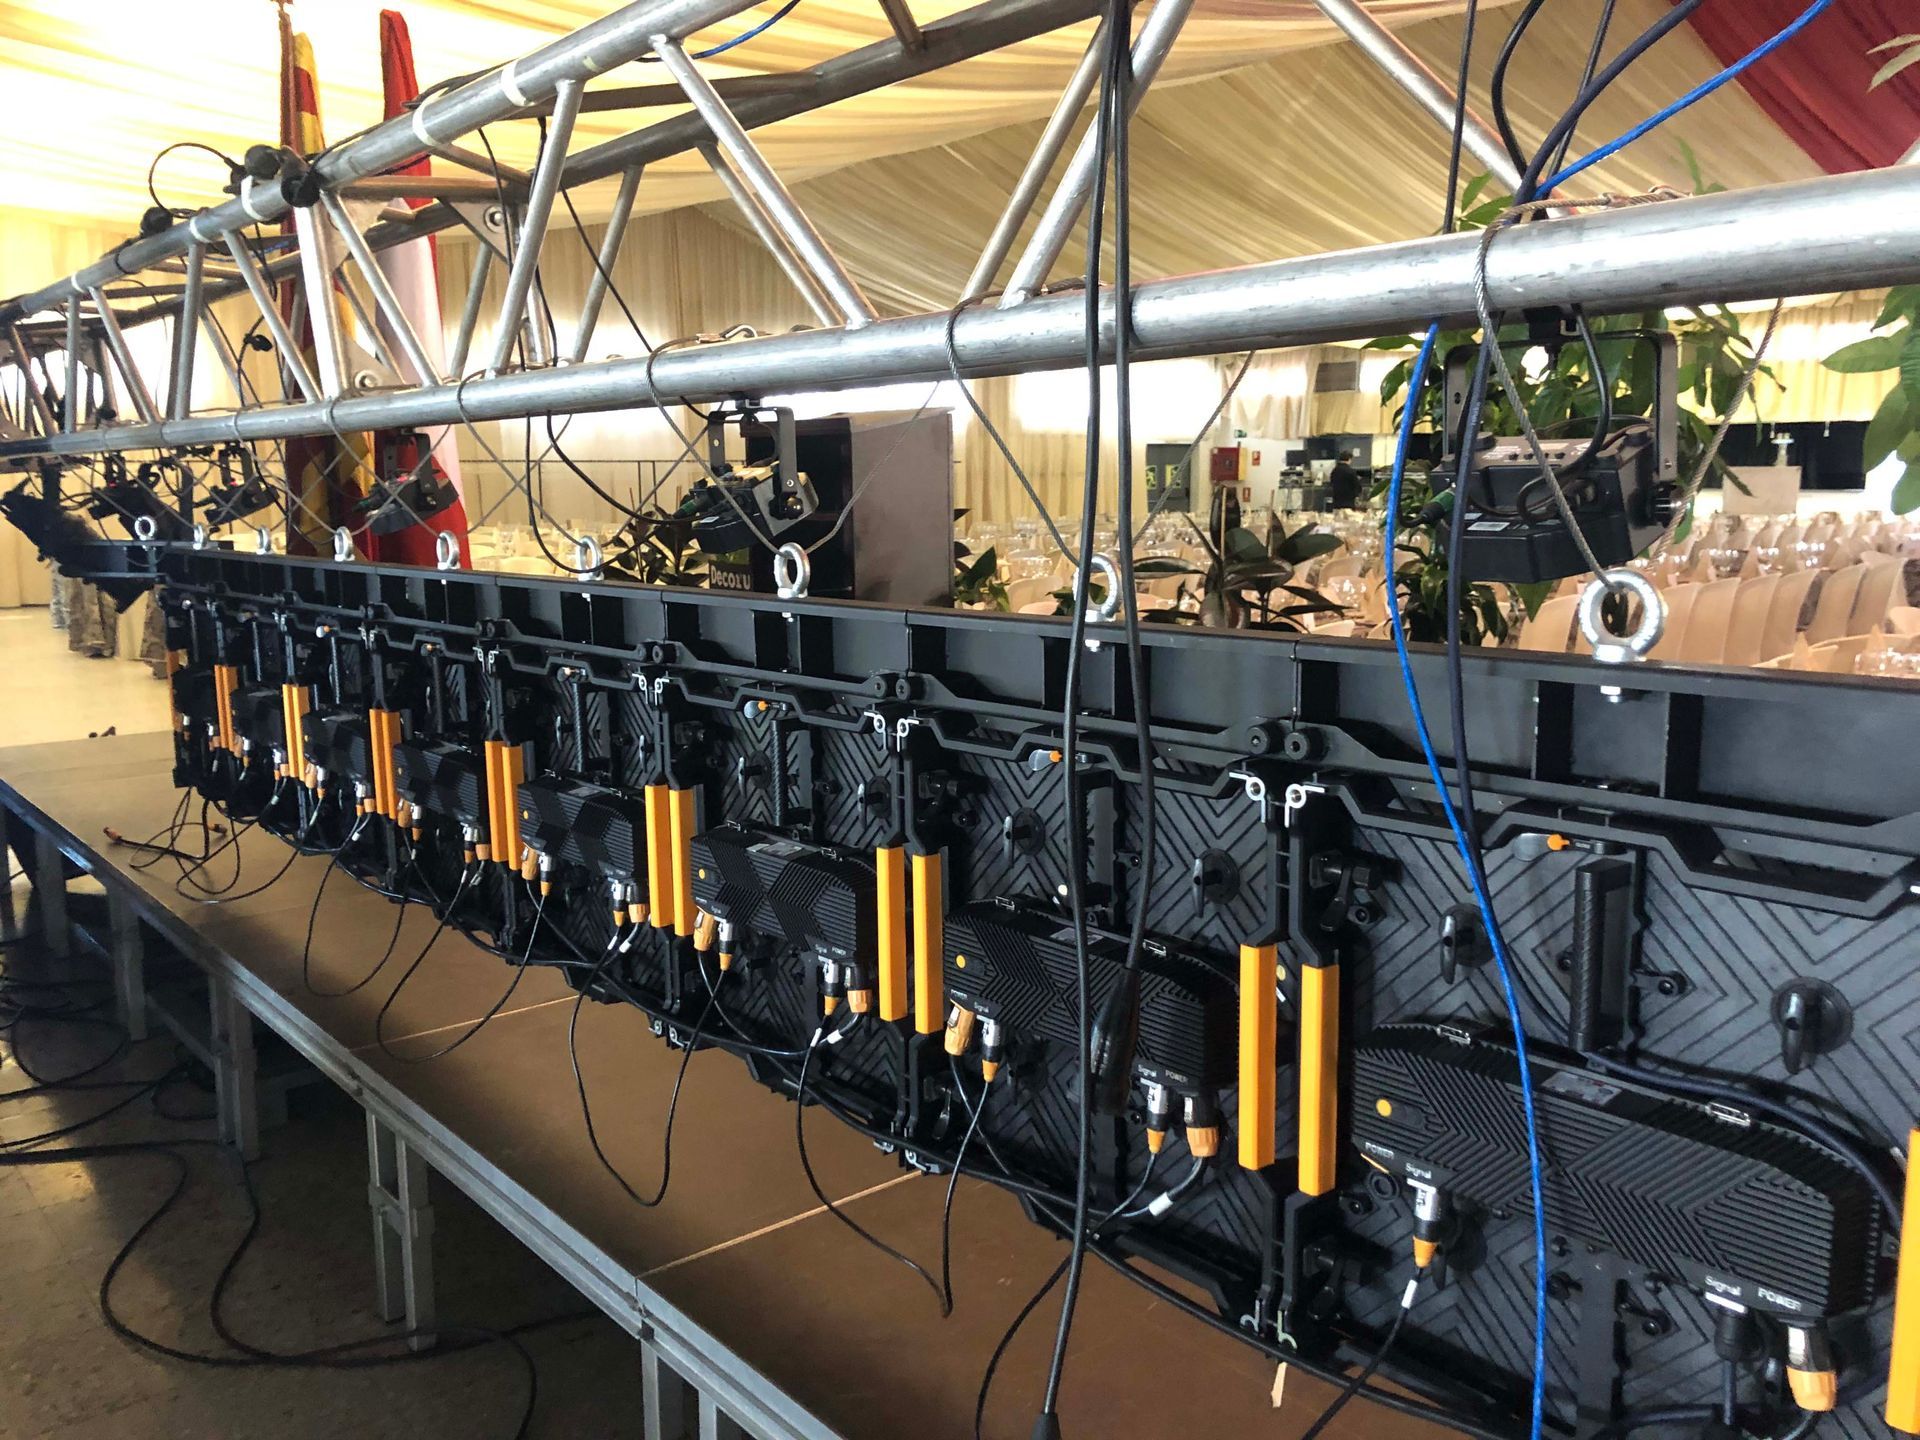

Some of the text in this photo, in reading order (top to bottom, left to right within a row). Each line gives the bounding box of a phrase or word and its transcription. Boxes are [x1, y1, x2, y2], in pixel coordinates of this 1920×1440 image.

[1364, 1141, 1395, 1160] POWER
[1405, 1162, 1432, 1179] Signal
[1704, 1275, 1741, 1296] Signal
[1757, 1286, 1802, 1312] POWER
